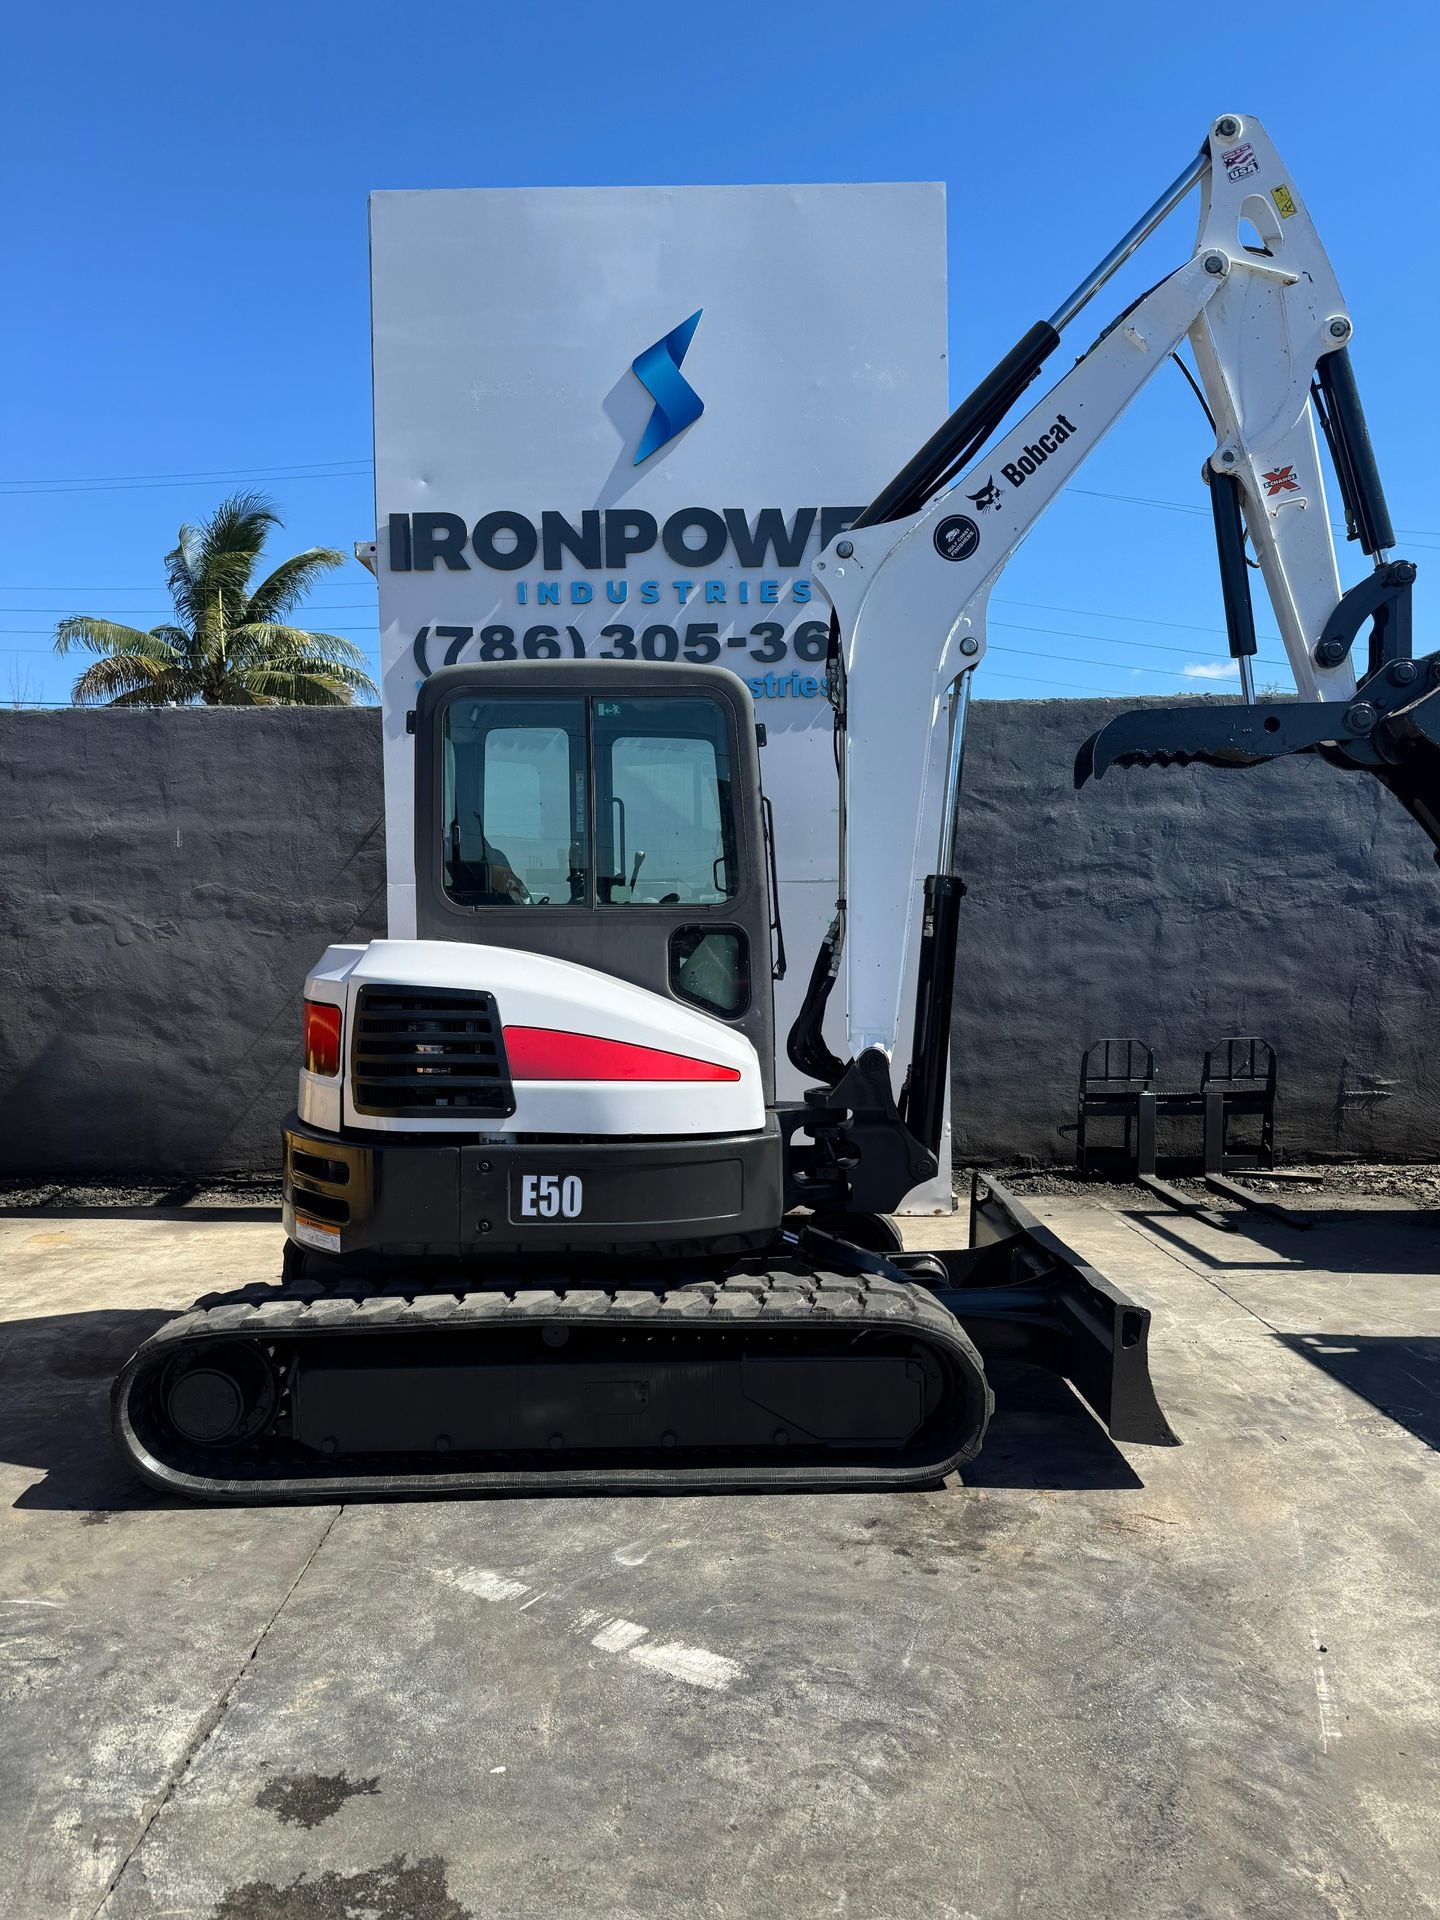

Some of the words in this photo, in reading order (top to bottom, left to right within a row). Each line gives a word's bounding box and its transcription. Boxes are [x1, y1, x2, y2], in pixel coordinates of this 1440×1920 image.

[1230, 164, 1257, 179] USA
[1001, 414, 1077, 488] Bobcat
[947, 541, 958, 553] GULF
[957, 528, 970, 542] COAST
[951, 531, 974, 556] FINISHERS
[517, 580, 812, 605] INDUSTRIES
[413, 624, 585, 678] (786)
[522, 1175, 582, 1217] E50
